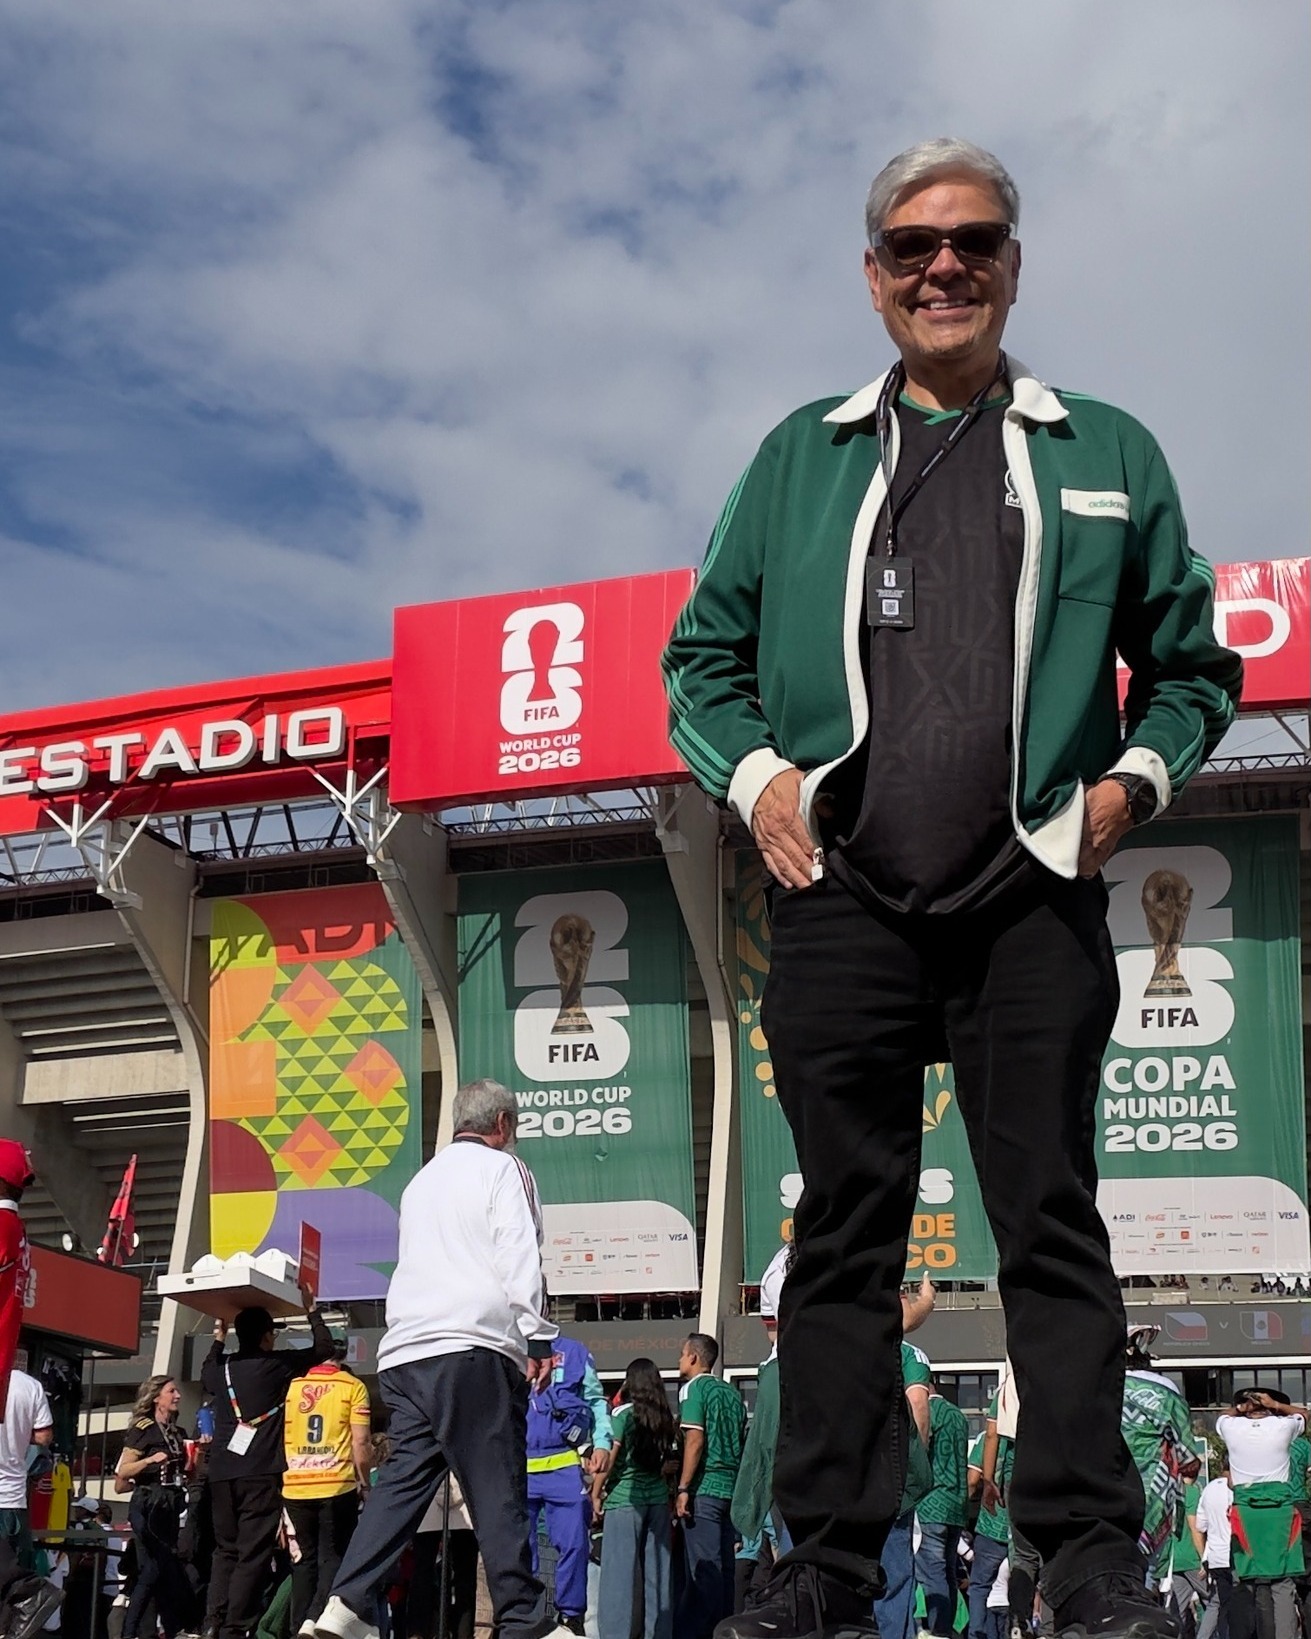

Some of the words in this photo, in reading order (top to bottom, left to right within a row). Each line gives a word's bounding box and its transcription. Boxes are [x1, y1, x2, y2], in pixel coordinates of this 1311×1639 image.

[1088, 499, 1124, 510] adidas
[524, 706, 560, 722] FIFA
[0, 706, 345, 795] ESTADIO
[500, 737, 551, 753] WORLD
[553, 733, 582, 747] CUP
[499, 747, 581, 775] 2026
[1141, 1007, 1199, 1028] FIFA
[548, 1043, 600, 1063] FIFA
[1103, 1054, 1237, 1093] COPA
[515, 1088, 588, 1107] WORLD
[591, 1086, 632, 1103] CUP
[1103, 1095, 1237, 1119] MUNDIAL
[516, 1107, 633, 1138] 2026
[1104, 1122, 1239, 1153] 2026
[913, 1213, 956, 1239] DE
[1278, 1211, 1300, 1220] VISA
[668, 1233, 688, 1241] VISA
[307, 1414, 324, 1445] 9
